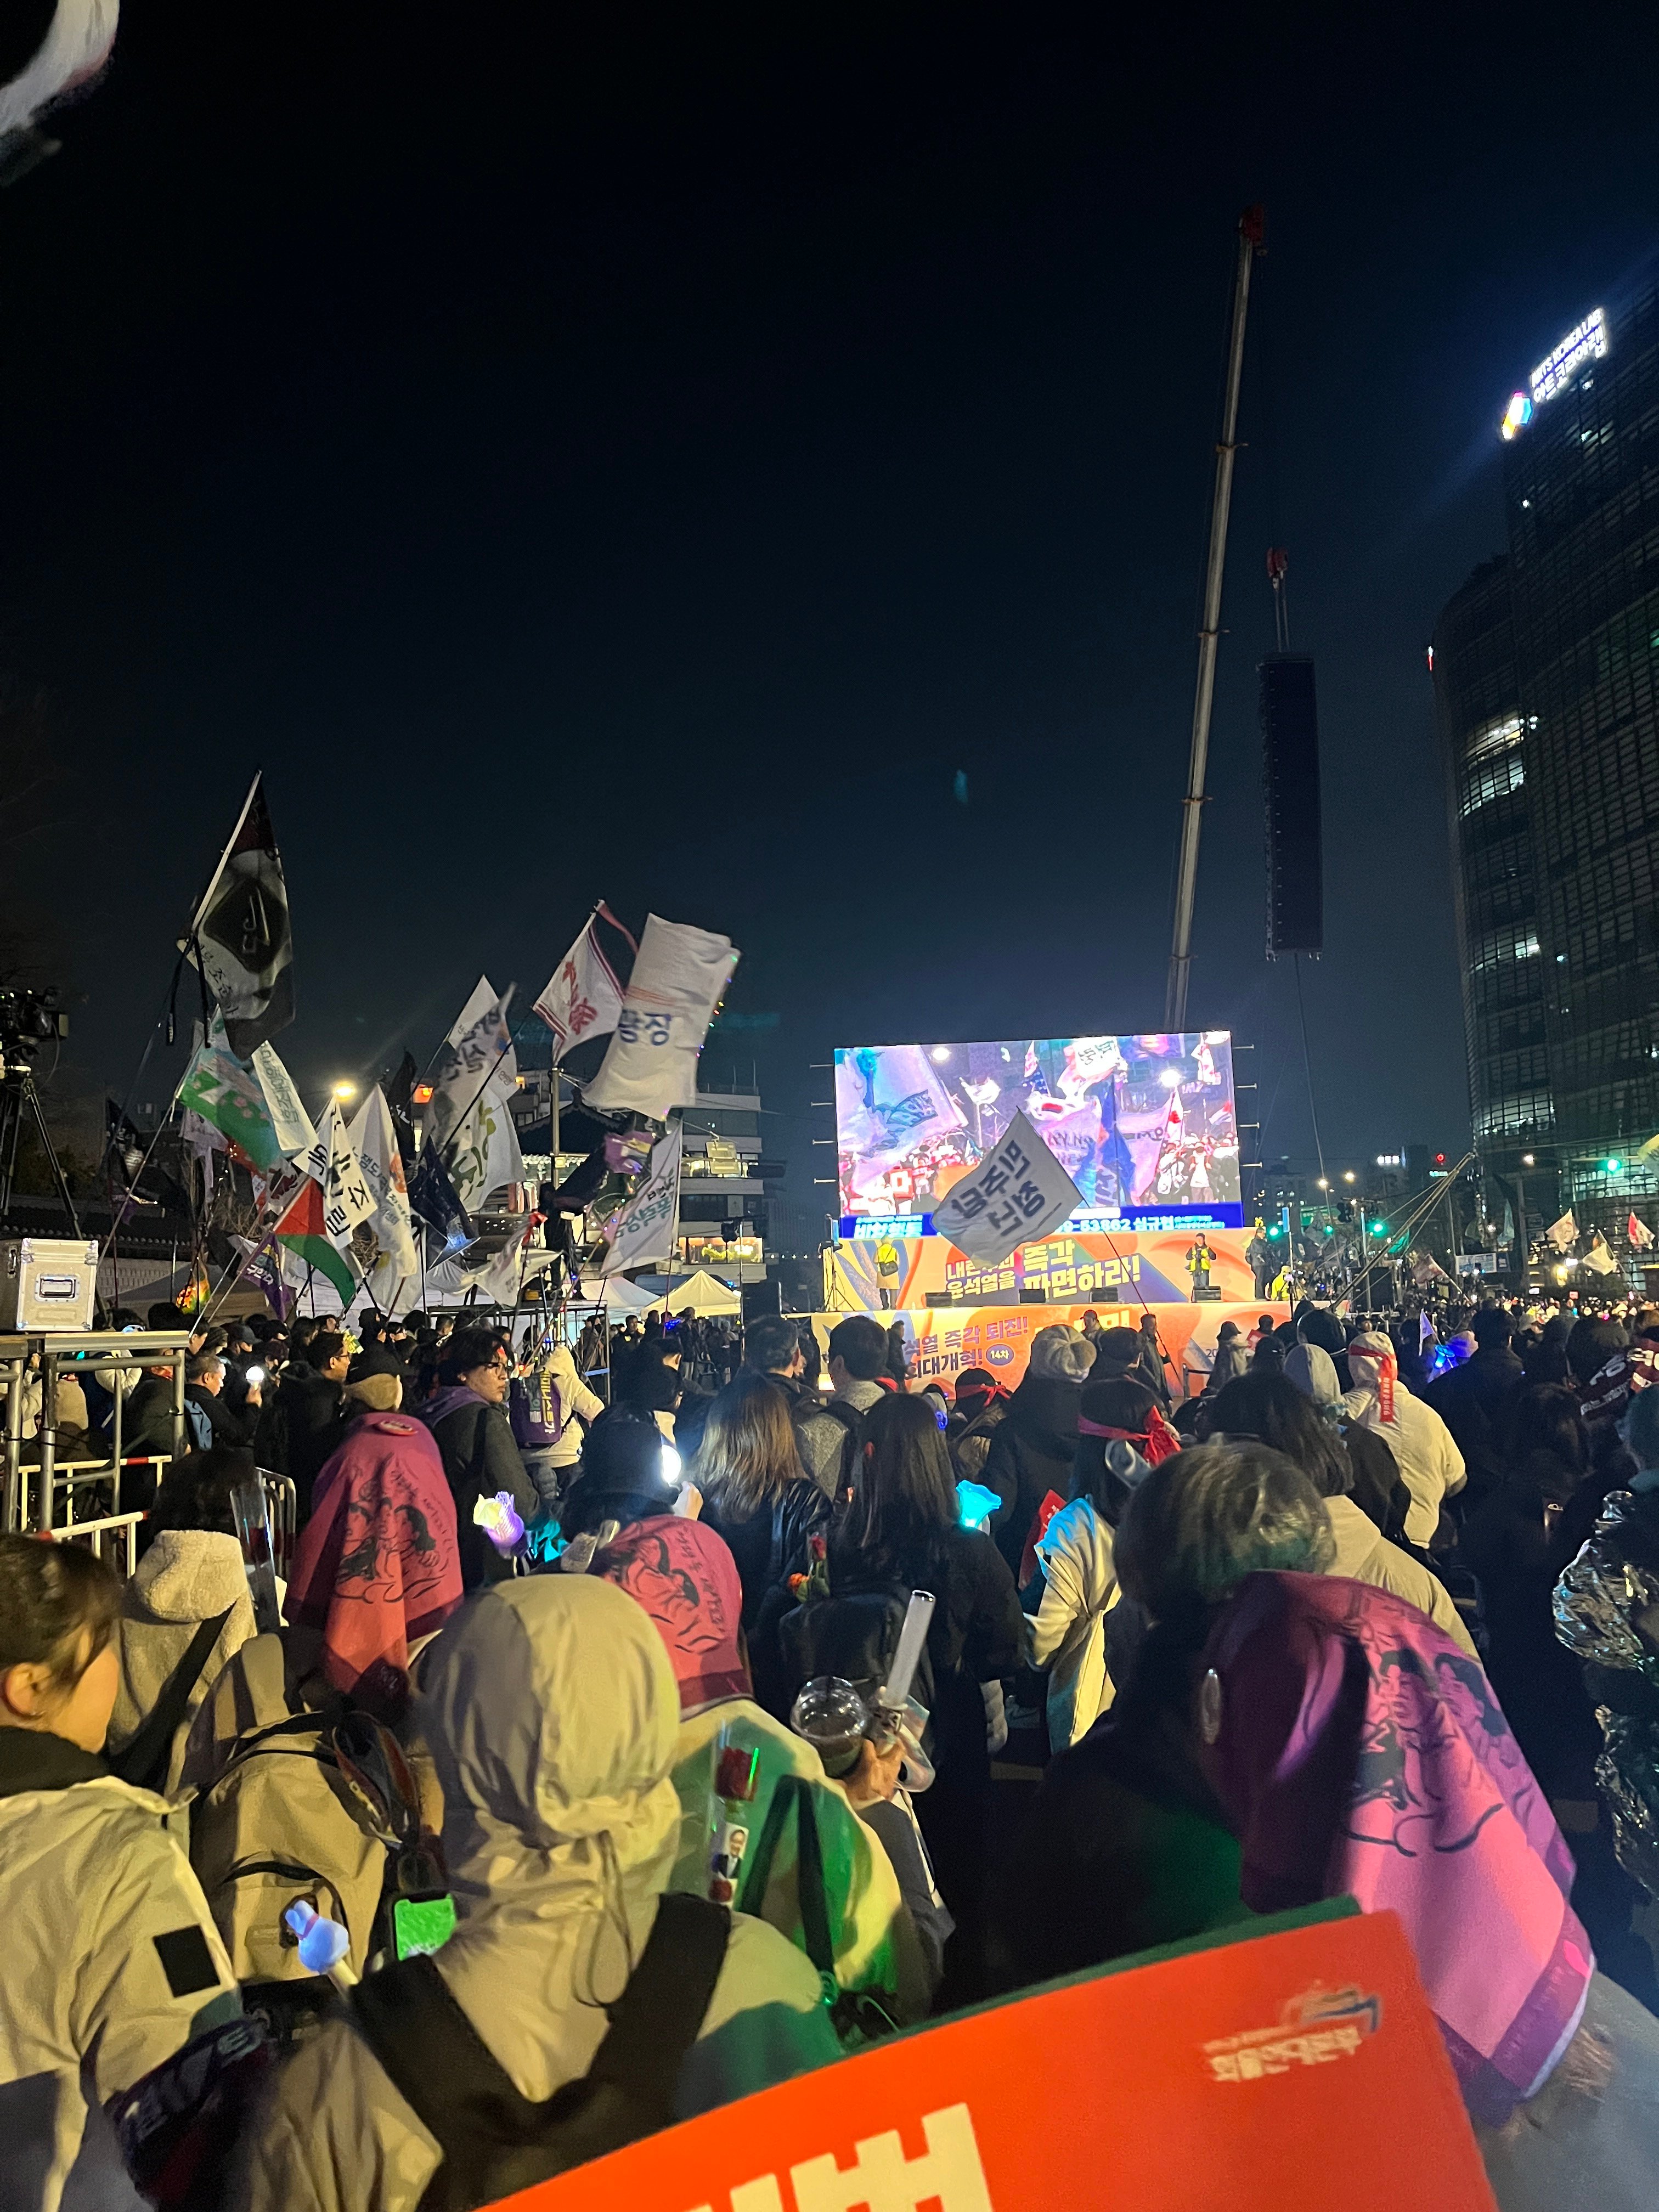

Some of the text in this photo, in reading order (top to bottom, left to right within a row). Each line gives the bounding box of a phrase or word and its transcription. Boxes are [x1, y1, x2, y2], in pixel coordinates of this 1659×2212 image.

[1531, 308, 1602, 387] ARTS KOREA LAB
[1023, 1239, 1075, 1272] 즉각
[946, 1254, 1141, 1300] 윤석열을 파면하라!
[904, 1334, 938, 1357] 석열
[944, 1325, 981, 1349] 즉각
[986, 1316, 1029, 1340] 퇴진!
[905, 1347, 1009, 1380] 회대개혁! 14차
